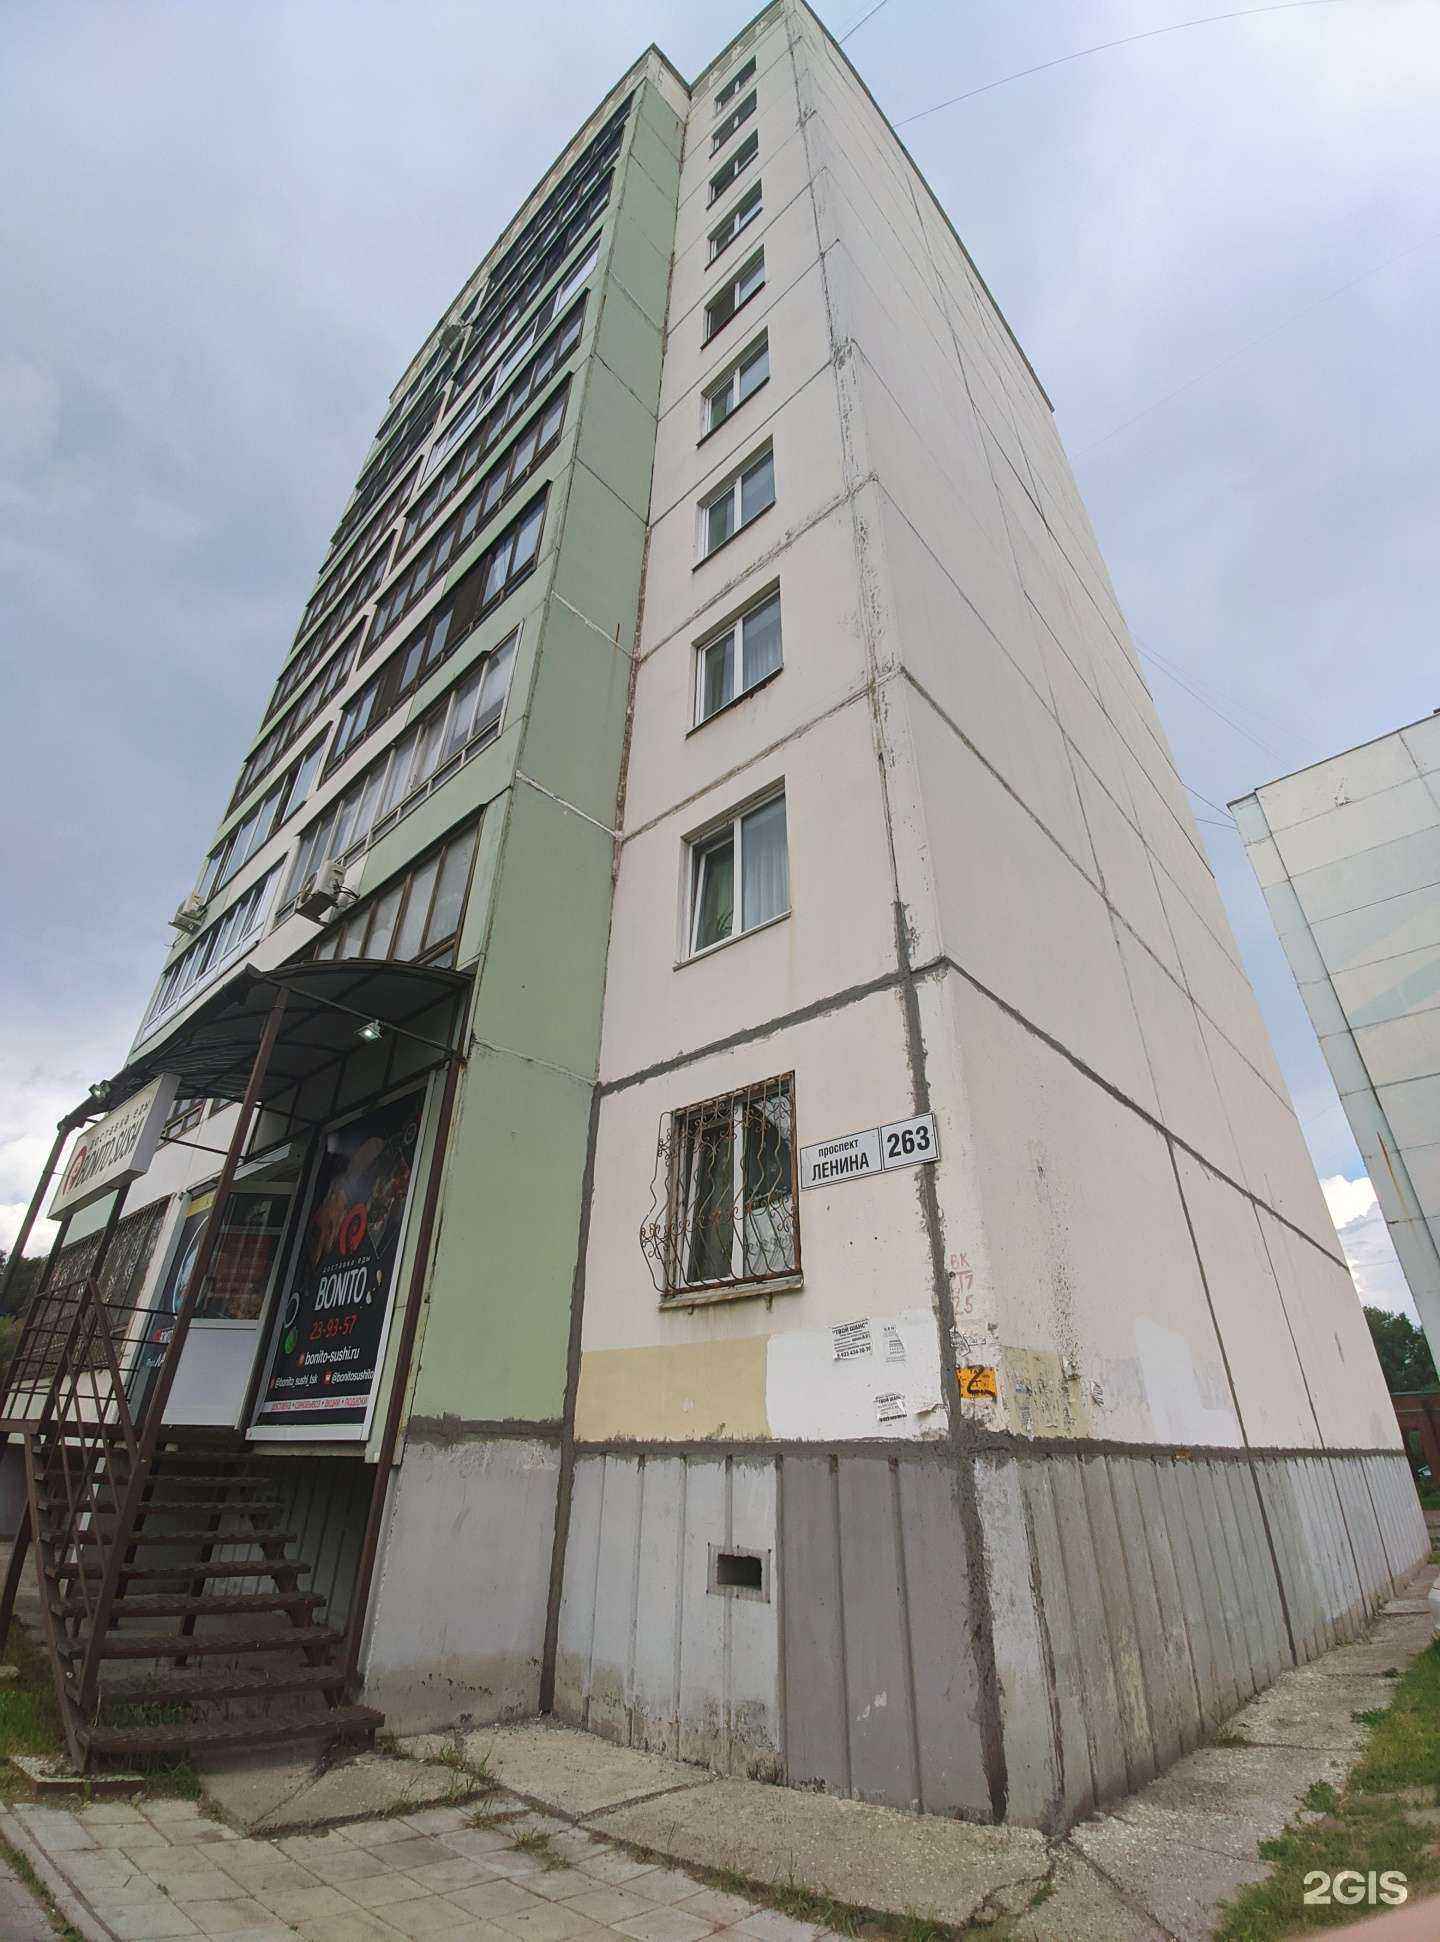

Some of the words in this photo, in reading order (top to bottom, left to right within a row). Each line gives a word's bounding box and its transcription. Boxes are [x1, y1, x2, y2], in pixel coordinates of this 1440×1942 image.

[818, 1139, 859, 1158] проспект
[886, 1125, 931, 1159] 263
[811, 1152, 870, 1181] ЛЕНИНА
[314, 1266, 368, 1311] BONITO
[309, 1313, 359, 1341] 23-93-57
[304, 1346, 361, 1366] bonito-sushi.ru
